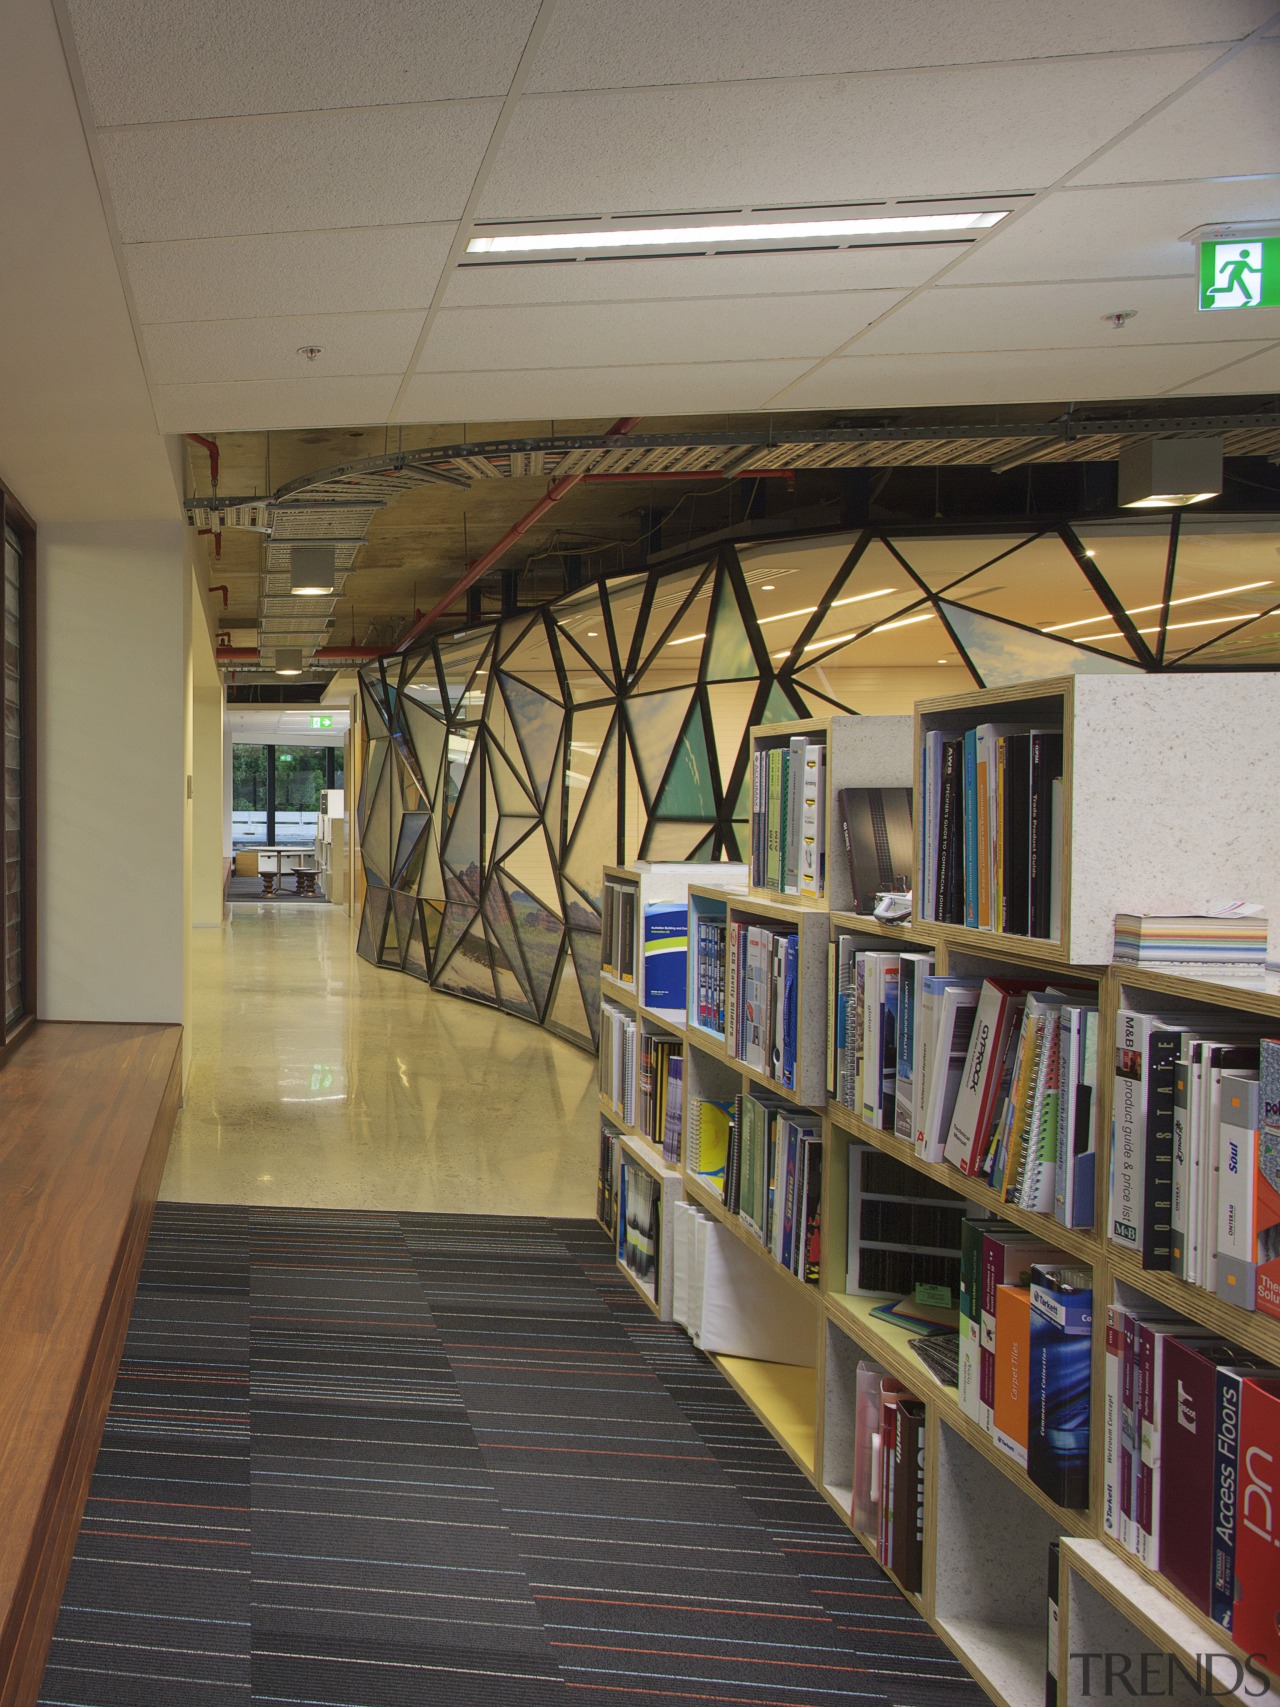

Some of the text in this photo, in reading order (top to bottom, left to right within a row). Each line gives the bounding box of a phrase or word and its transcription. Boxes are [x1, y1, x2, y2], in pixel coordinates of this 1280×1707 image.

[970, 1024, 990, 1093] GYPROCK
[1121, 1016, 1135, 1222] M&B product guide & price list
[1228, 1141, 1239, 1174] Soul
[1115, 1222, 1136, 1242] M&B
[1039, 1295, 1058, 1316] Tarkett
[1010, 1342, 1019, 1400] Carpet Tiles
[1216, 1386, 1238, 1547] Access Floors
